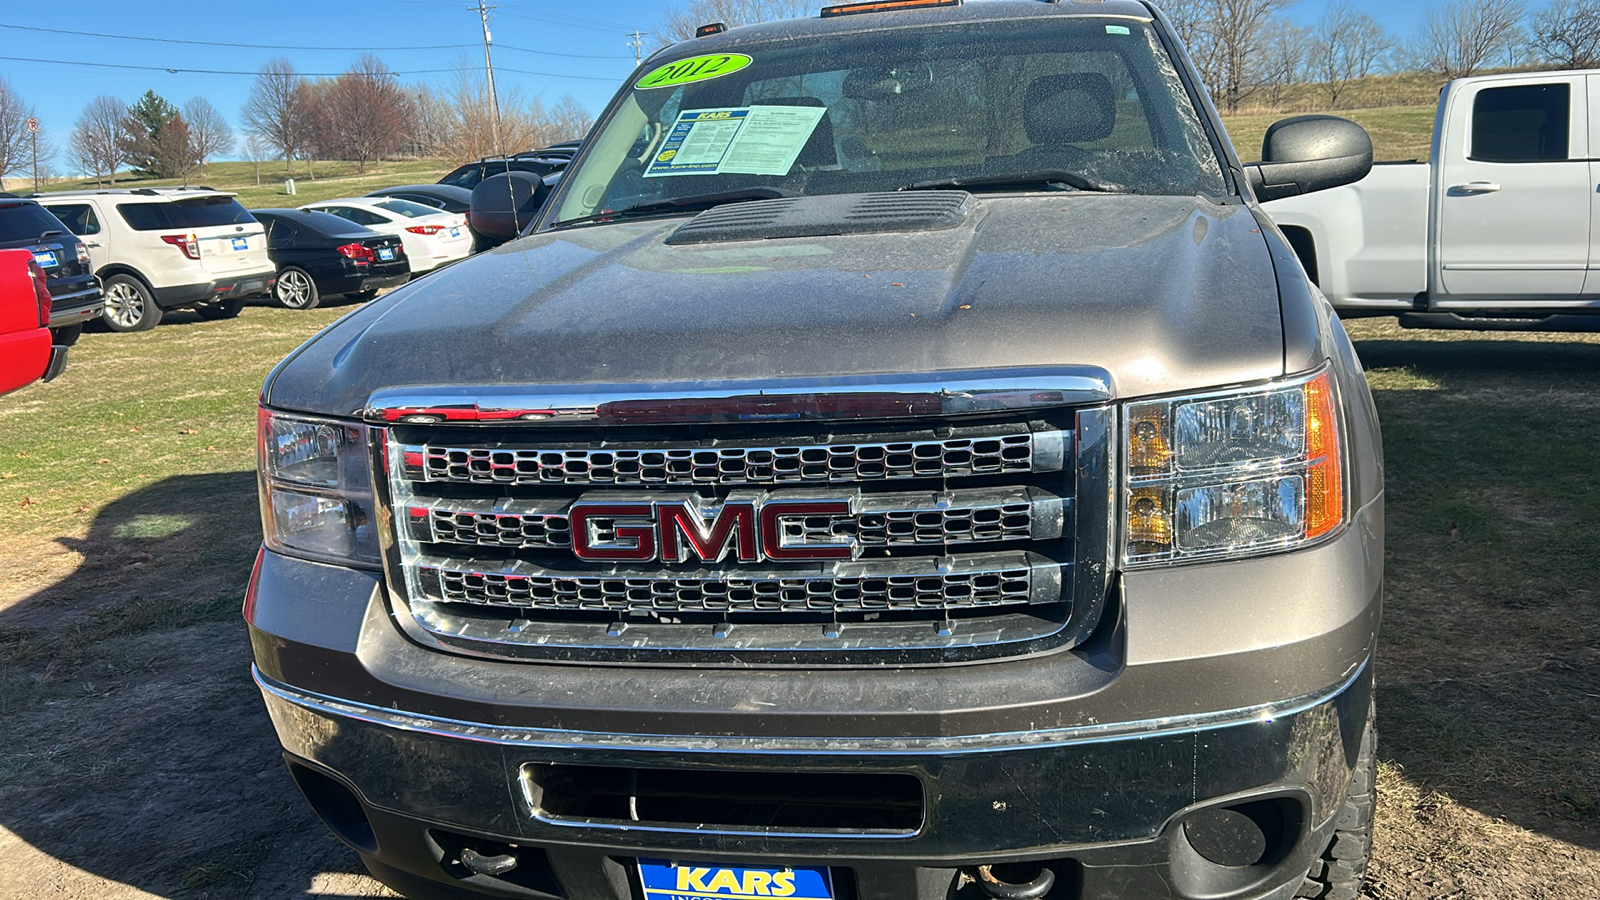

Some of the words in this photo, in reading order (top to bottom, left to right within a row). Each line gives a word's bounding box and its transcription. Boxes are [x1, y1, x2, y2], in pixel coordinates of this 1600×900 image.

[650, 56, 731, 84] 2012
[697, 111, 732, 119] KARS
[569, 499, 858, 563] GMC
[676, 866, 796, 897] KARS
